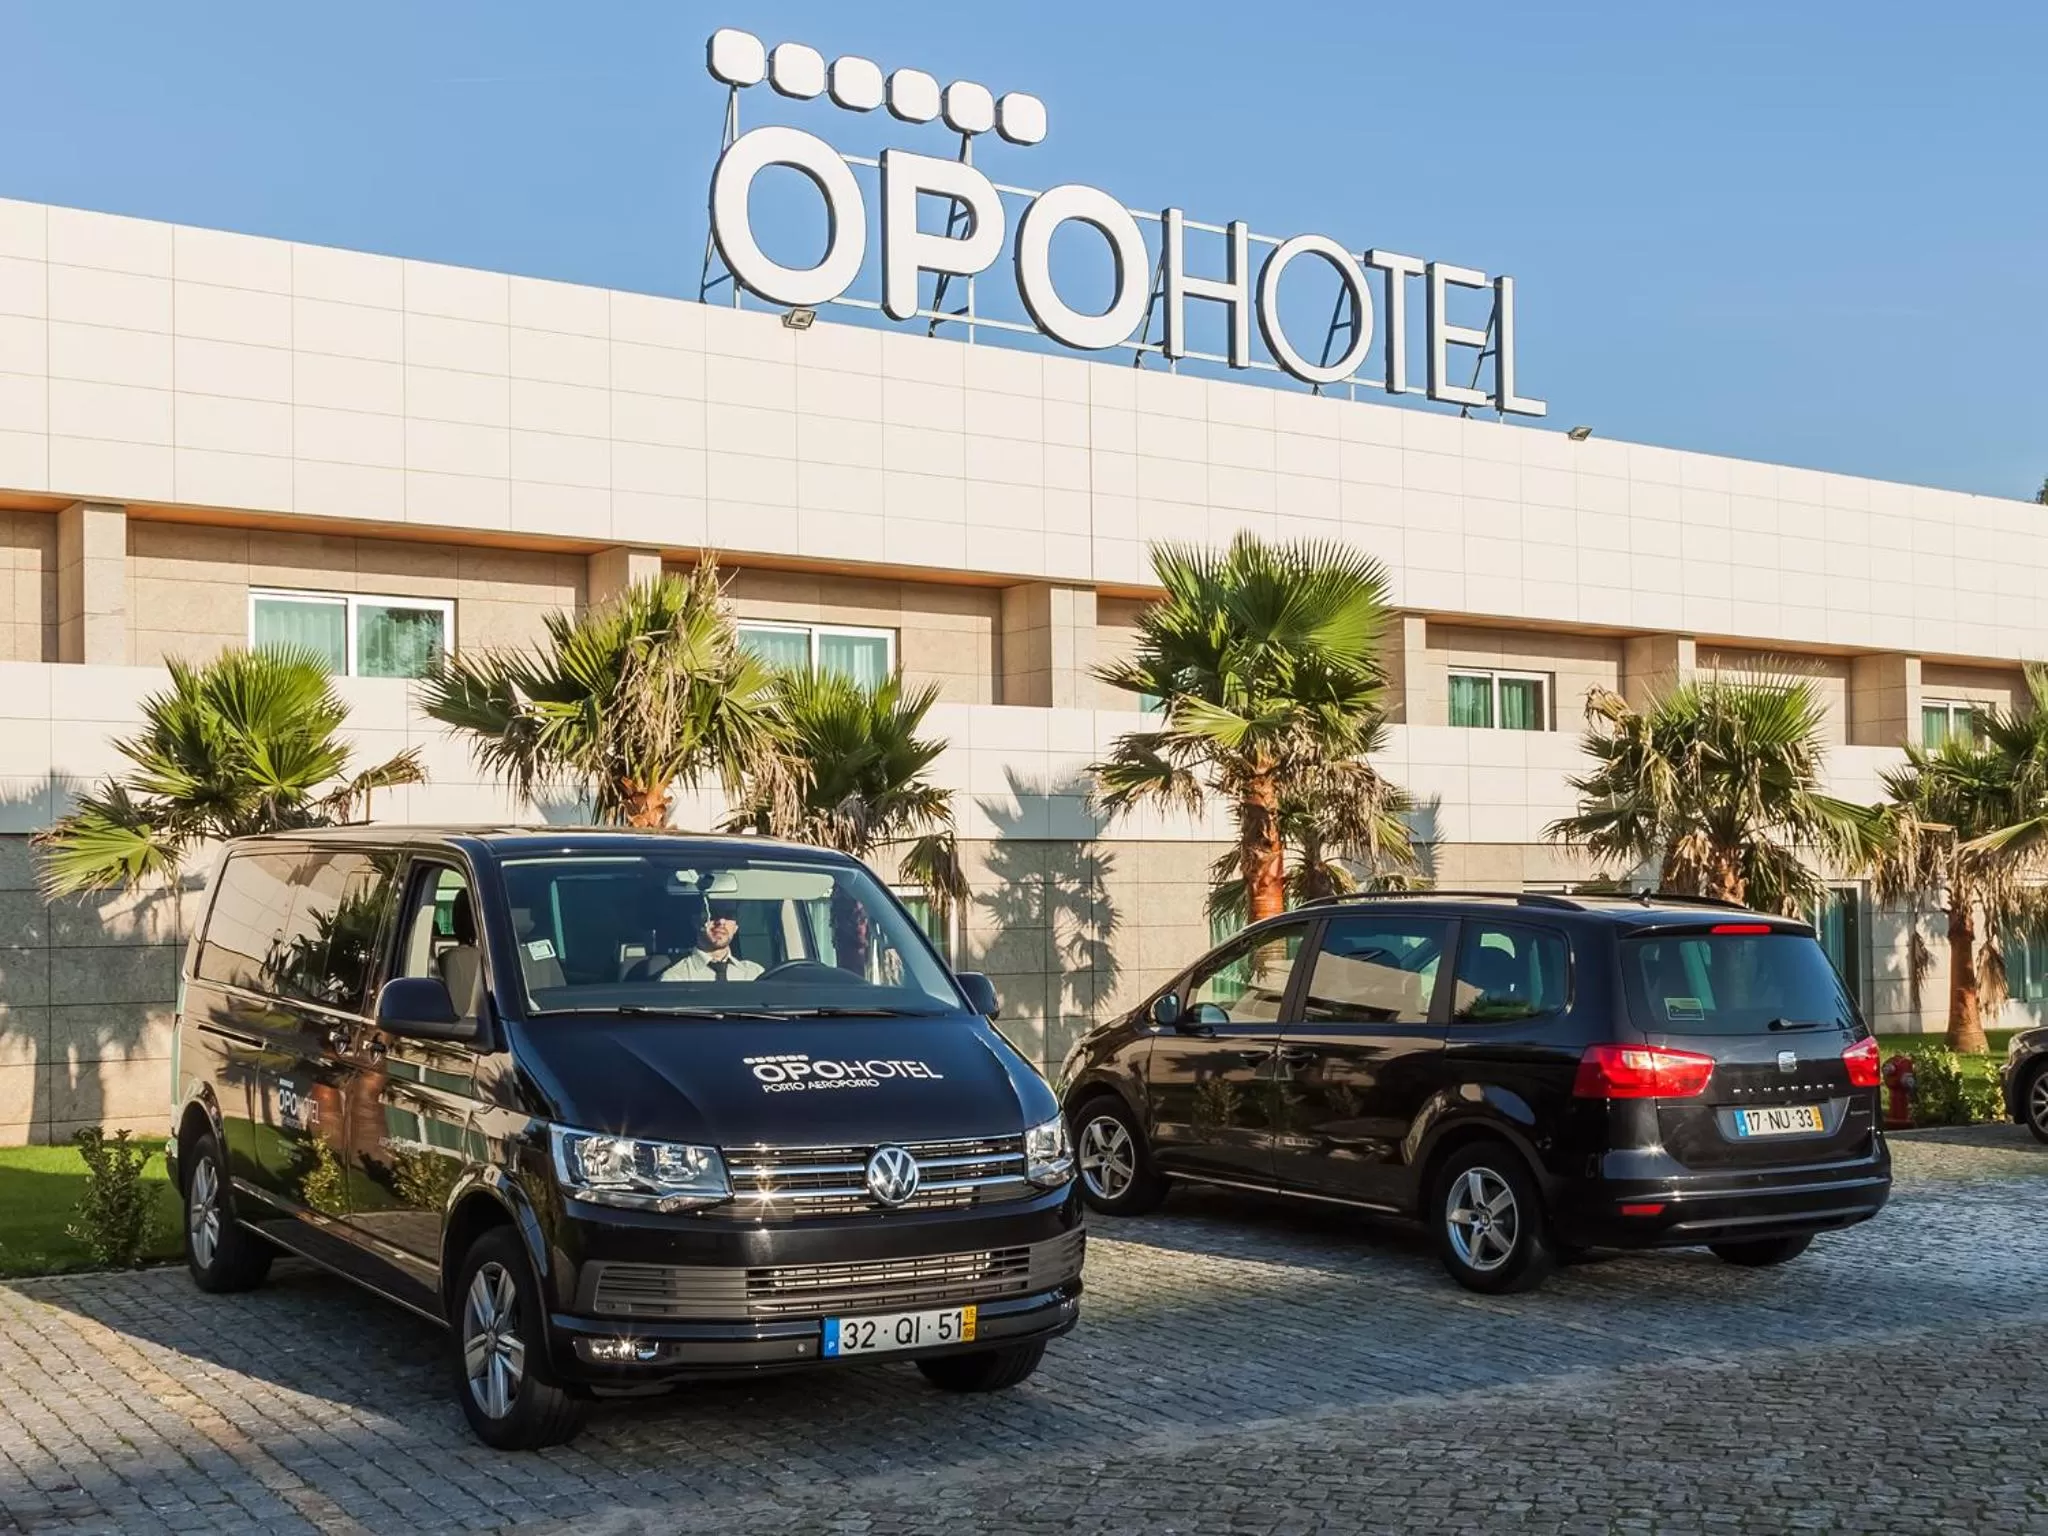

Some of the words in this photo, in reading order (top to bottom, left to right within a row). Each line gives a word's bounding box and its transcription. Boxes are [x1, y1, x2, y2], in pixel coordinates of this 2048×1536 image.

[709, 126, 1547, 417] OPOHOTEL
[753, 1060, 944, 1082] OPOHOTEL
[762, 1081, 805, 1093] PORTO
[807, 1078, 880, 1090] AEROPORTO
